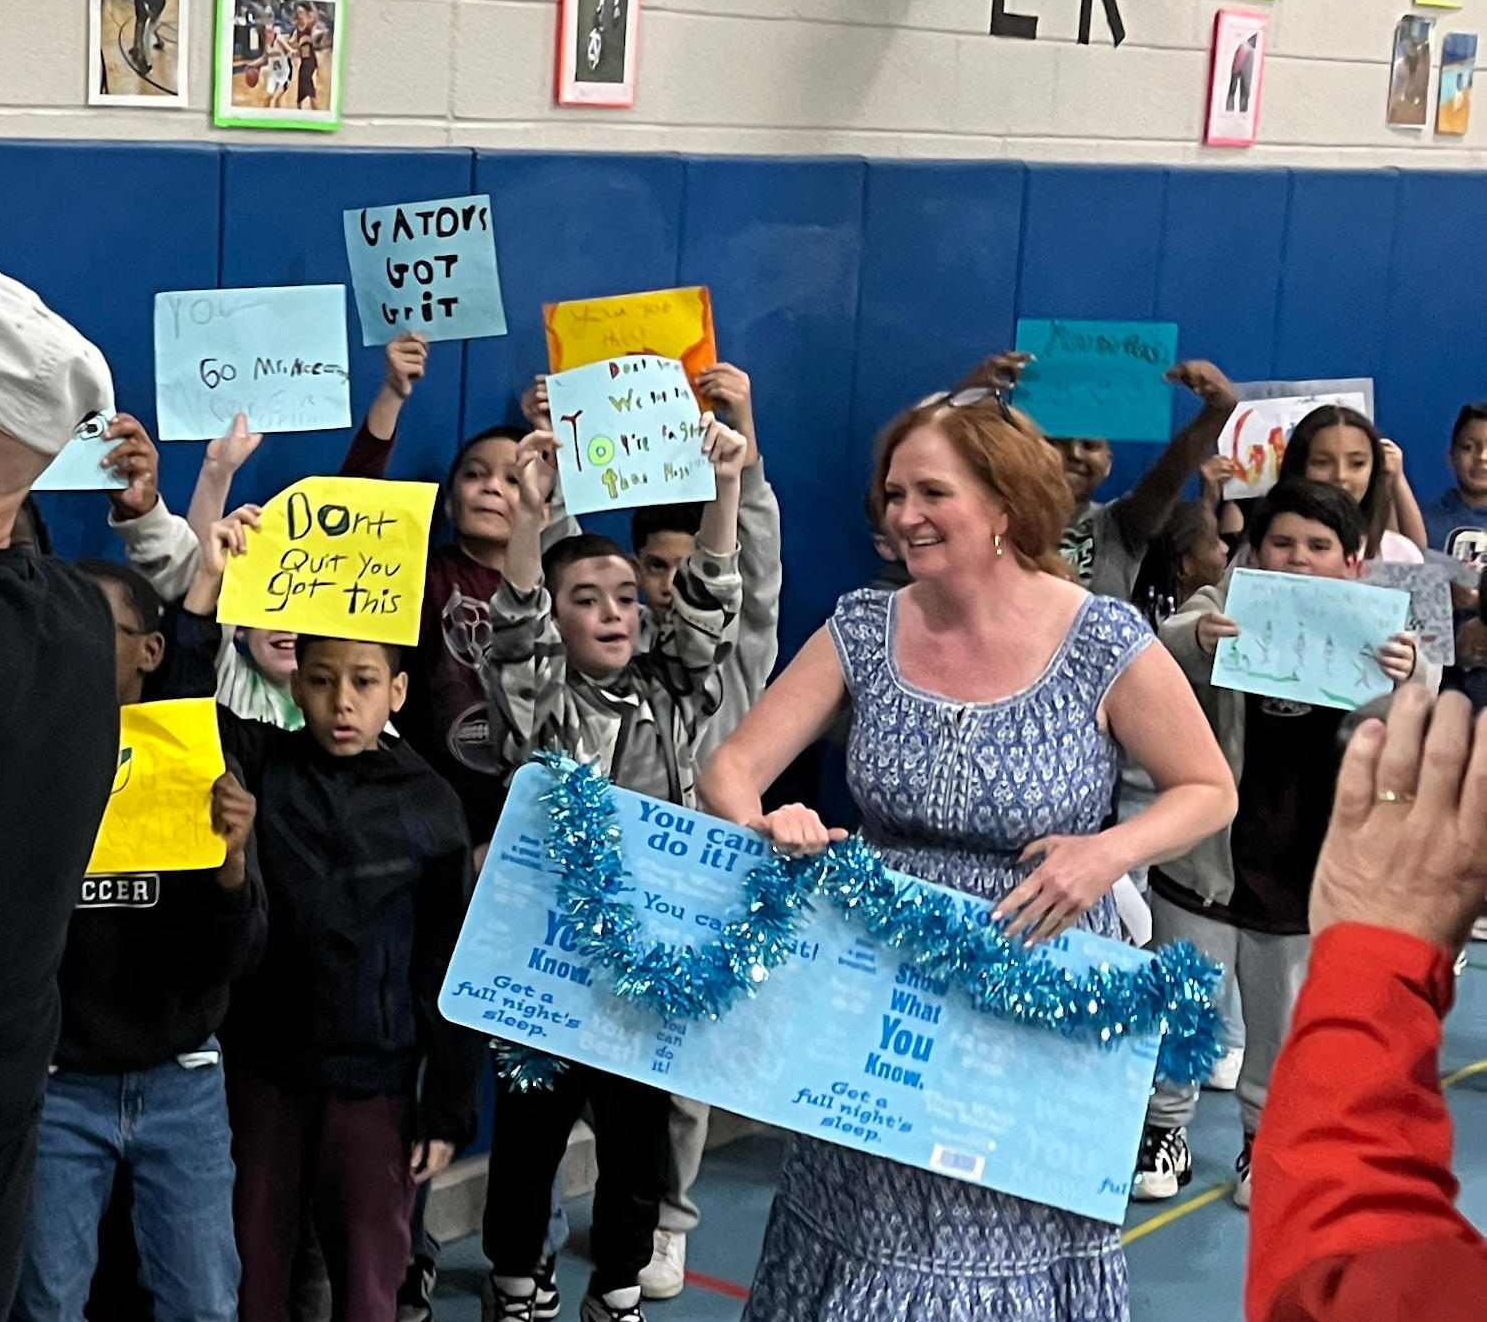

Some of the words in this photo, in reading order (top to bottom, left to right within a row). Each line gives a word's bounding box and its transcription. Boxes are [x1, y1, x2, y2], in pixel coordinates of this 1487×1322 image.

[386, 254, 459, 289] GOT
[264, 570, 337, 613] got
[342, 582, 402, 615] this
[638, 799, 695, 836] You
[706, 827, 763, 858] can
[647, 831, 688, 857] do
[700, 845, 739, 873] it!
[81, 880, 149, 902] CCER
[544, 909, 578, 953] Yo
[643, 891, 685, 921] You
[695, 913, 725, 932] ca
[527, 946, 593, 988] Know.
[894, 961, 950, 997] Show
[451, 981, 497, 1003] full
[502, 997, 582, 1029] night's
[493, 975, 536, 998] Get
[541, 993, 554, 1005] a
[889, 987, 942, 1025] What
[481, 1009, 548, 1038] sleep.
[656, 1031, 682, 1047] can
[878, 1013, 935, 1063] You
[655, 1045, 674, 1060] do
[863, 1051, 925, 1090] Know.
[791, 1087, 835, 1110] full
[839, 1103, 913, 1133] night's
[831, 1081, 871, 1104] Get
[875, 1097, 888, 1109] a
